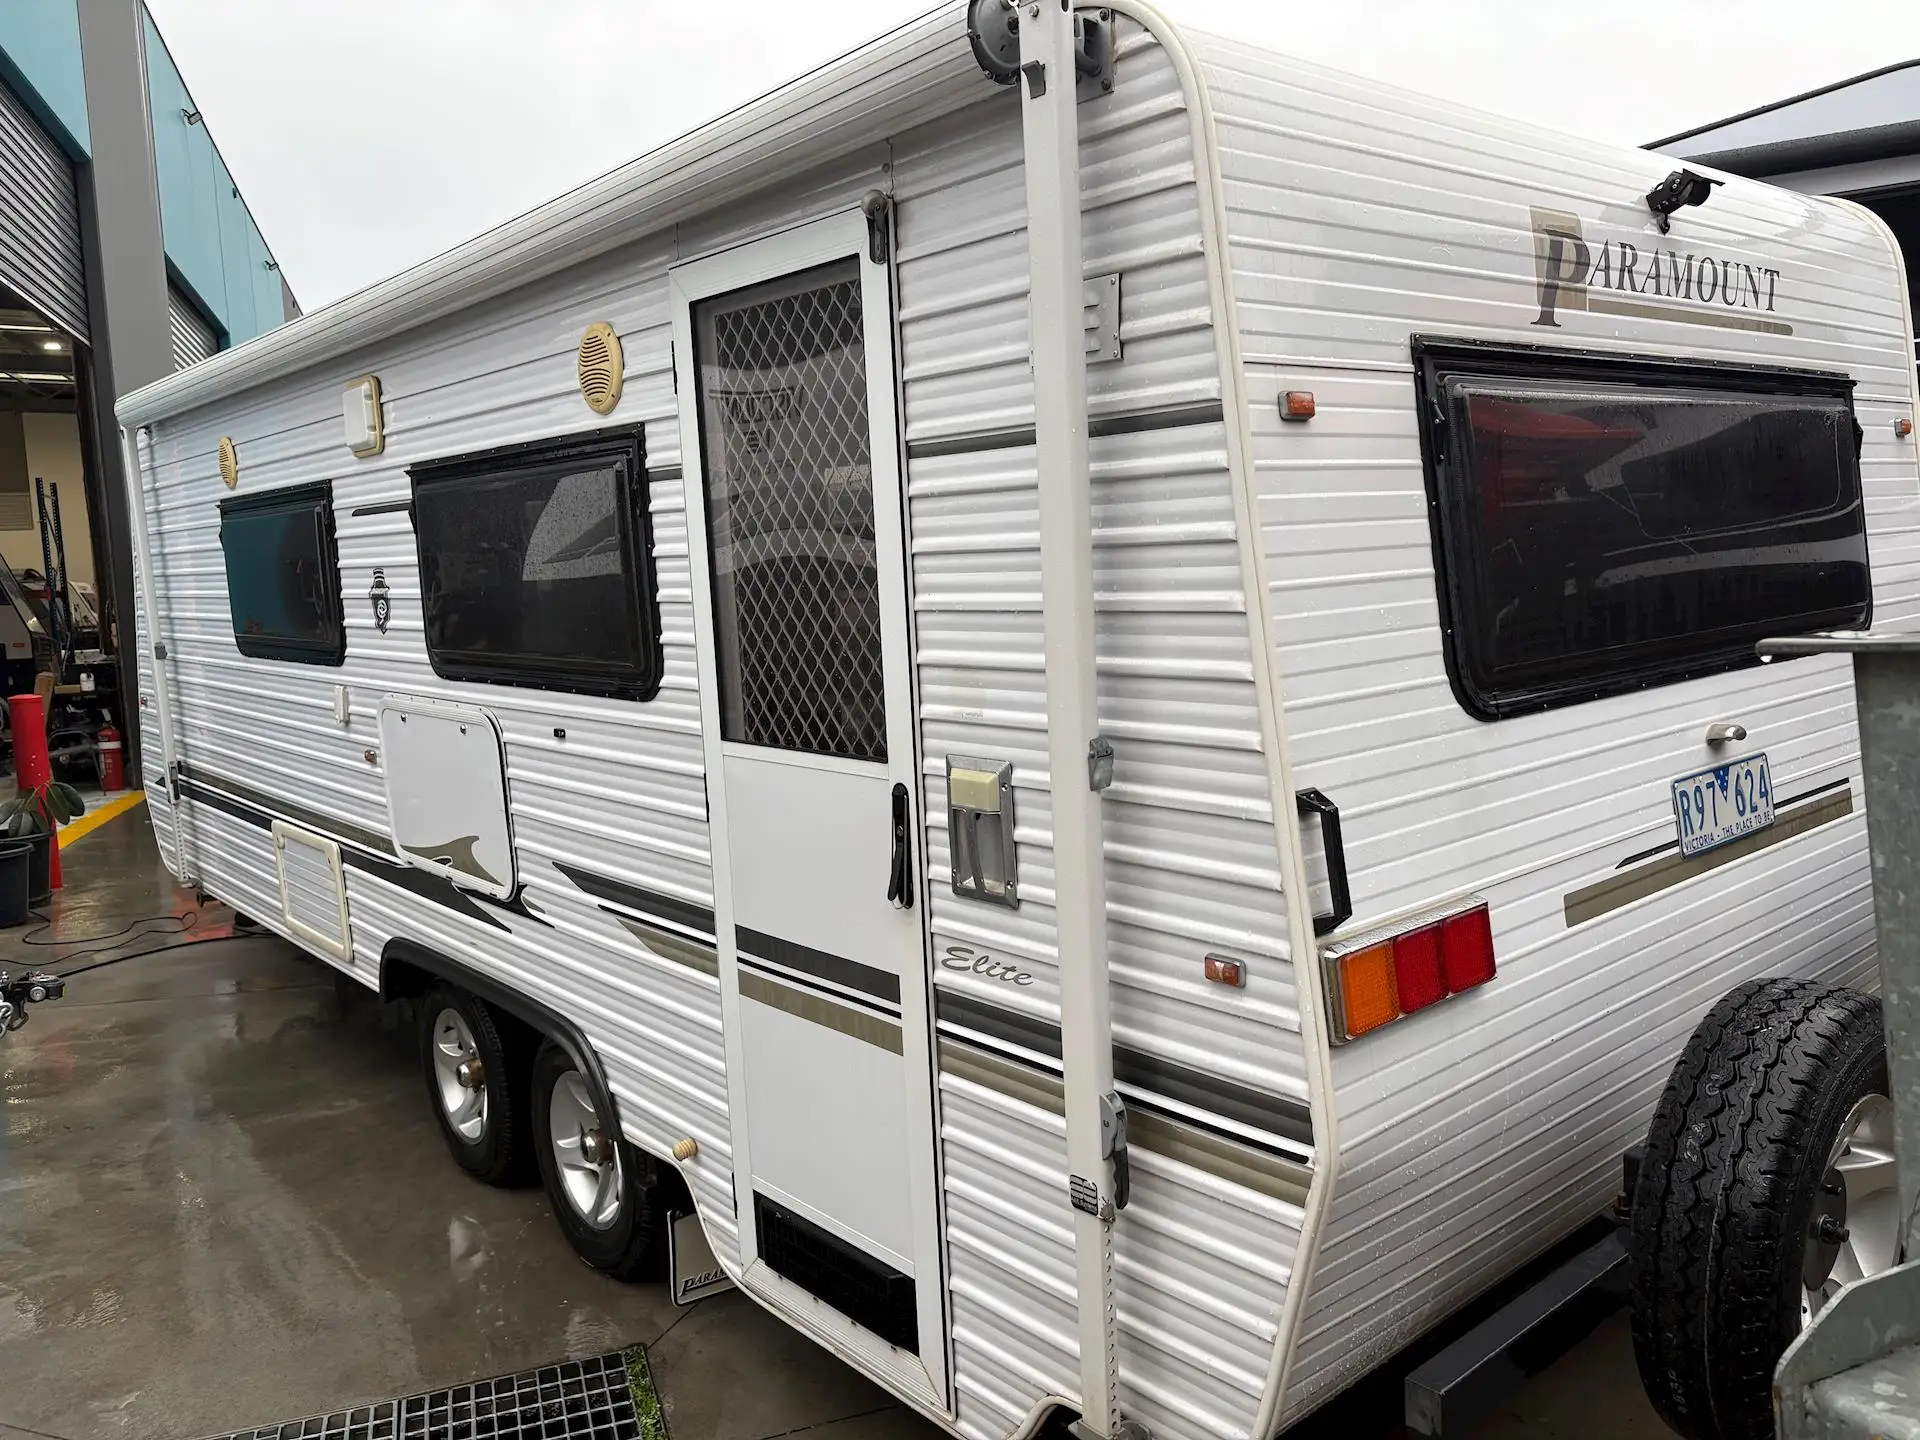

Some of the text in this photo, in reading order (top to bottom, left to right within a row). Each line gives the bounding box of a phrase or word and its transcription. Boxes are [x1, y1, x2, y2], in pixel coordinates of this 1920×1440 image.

[1530, 228, 1780, 327] PARAMOUNT
[1678, 764, 1769, 838] R97 624
[1685, 832, 1714, 851] VICTORIA
[1722, 824, 1734, 837] THE
[1736, 817, 1753, 832] PLACE
[1754, 814, 1762, 825] TO
[941, 946, 1034, 986] Elite
